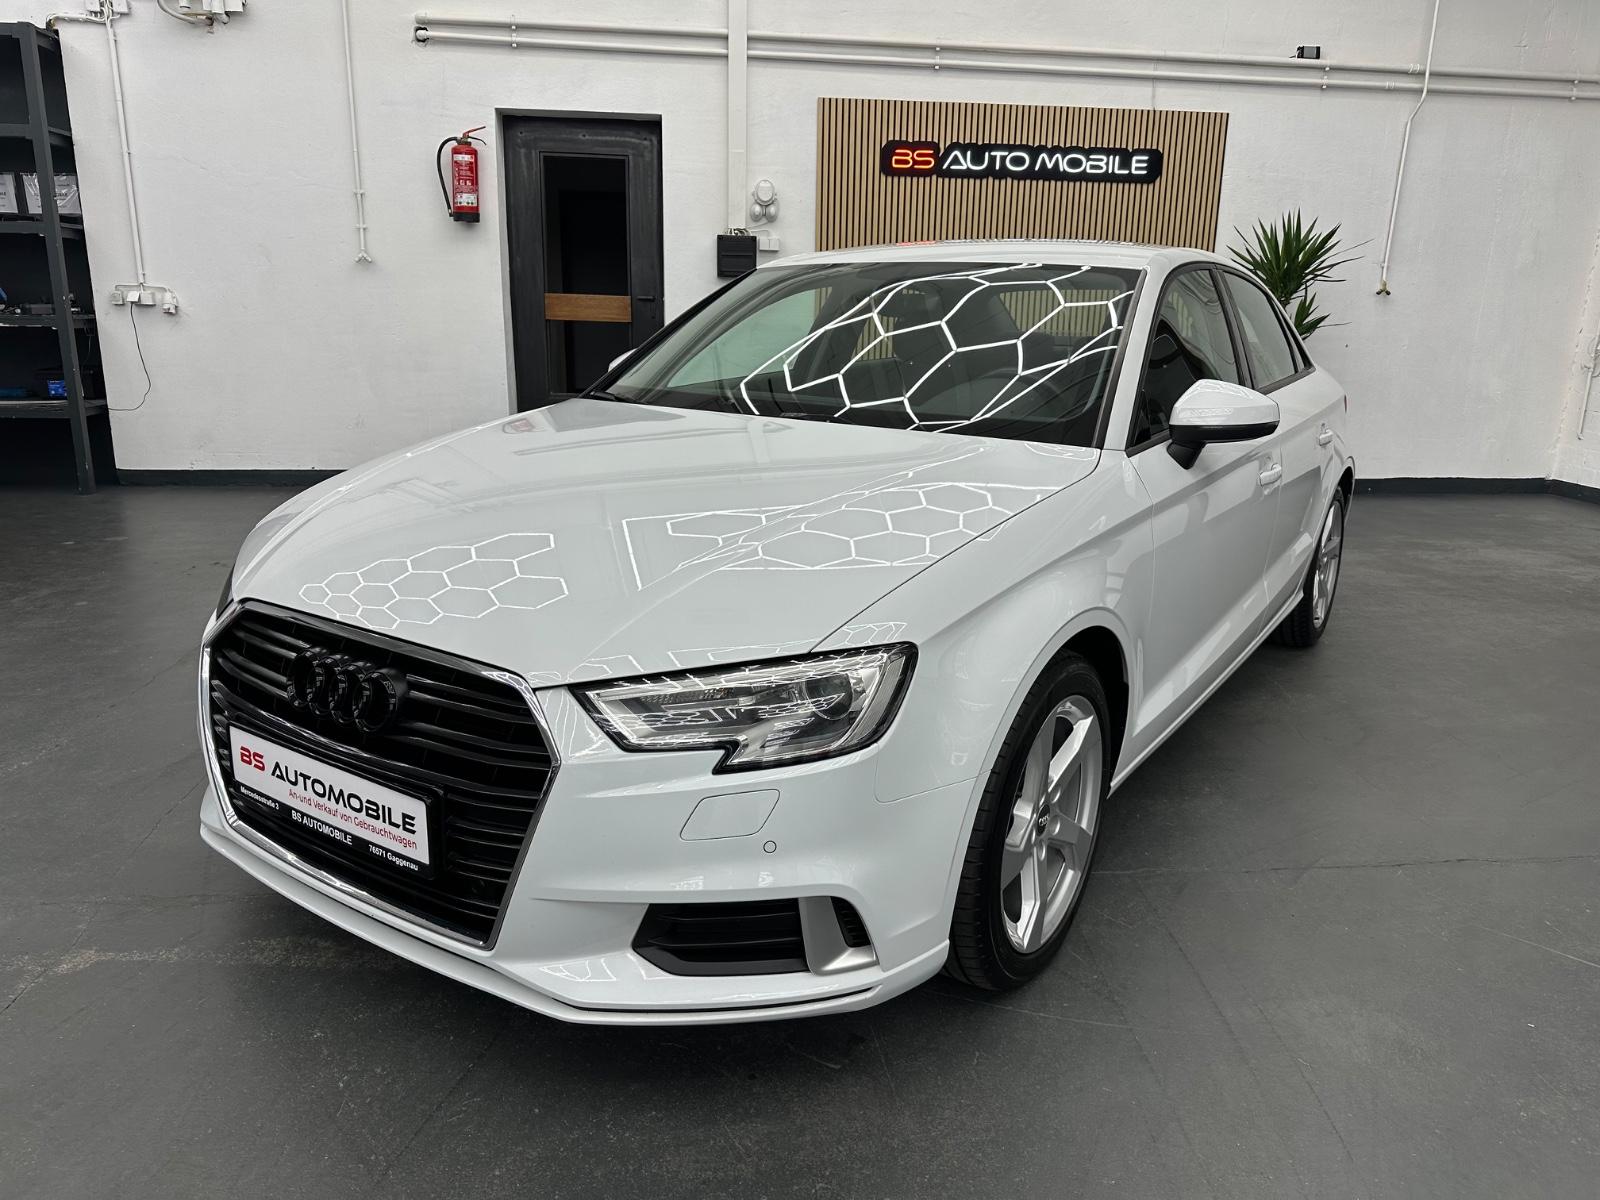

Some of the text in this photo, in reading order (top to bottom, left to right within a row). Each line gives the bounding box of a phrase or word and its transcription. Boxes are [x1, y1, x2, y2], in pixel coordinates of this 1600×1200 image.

[890, 148, 935, 169] BS
[240, 746, 417, 835] BS AUTOMOBILE
[291, 809, 353, 846] BS AUTOMOBILE
[312, 798, 339, 818] Verkauf
[339, 812, 353, 824] von
[353, 816, 418, 850] Gebrauchtwagen
[368, 844, 419, 871] 76571 Gaggenau
